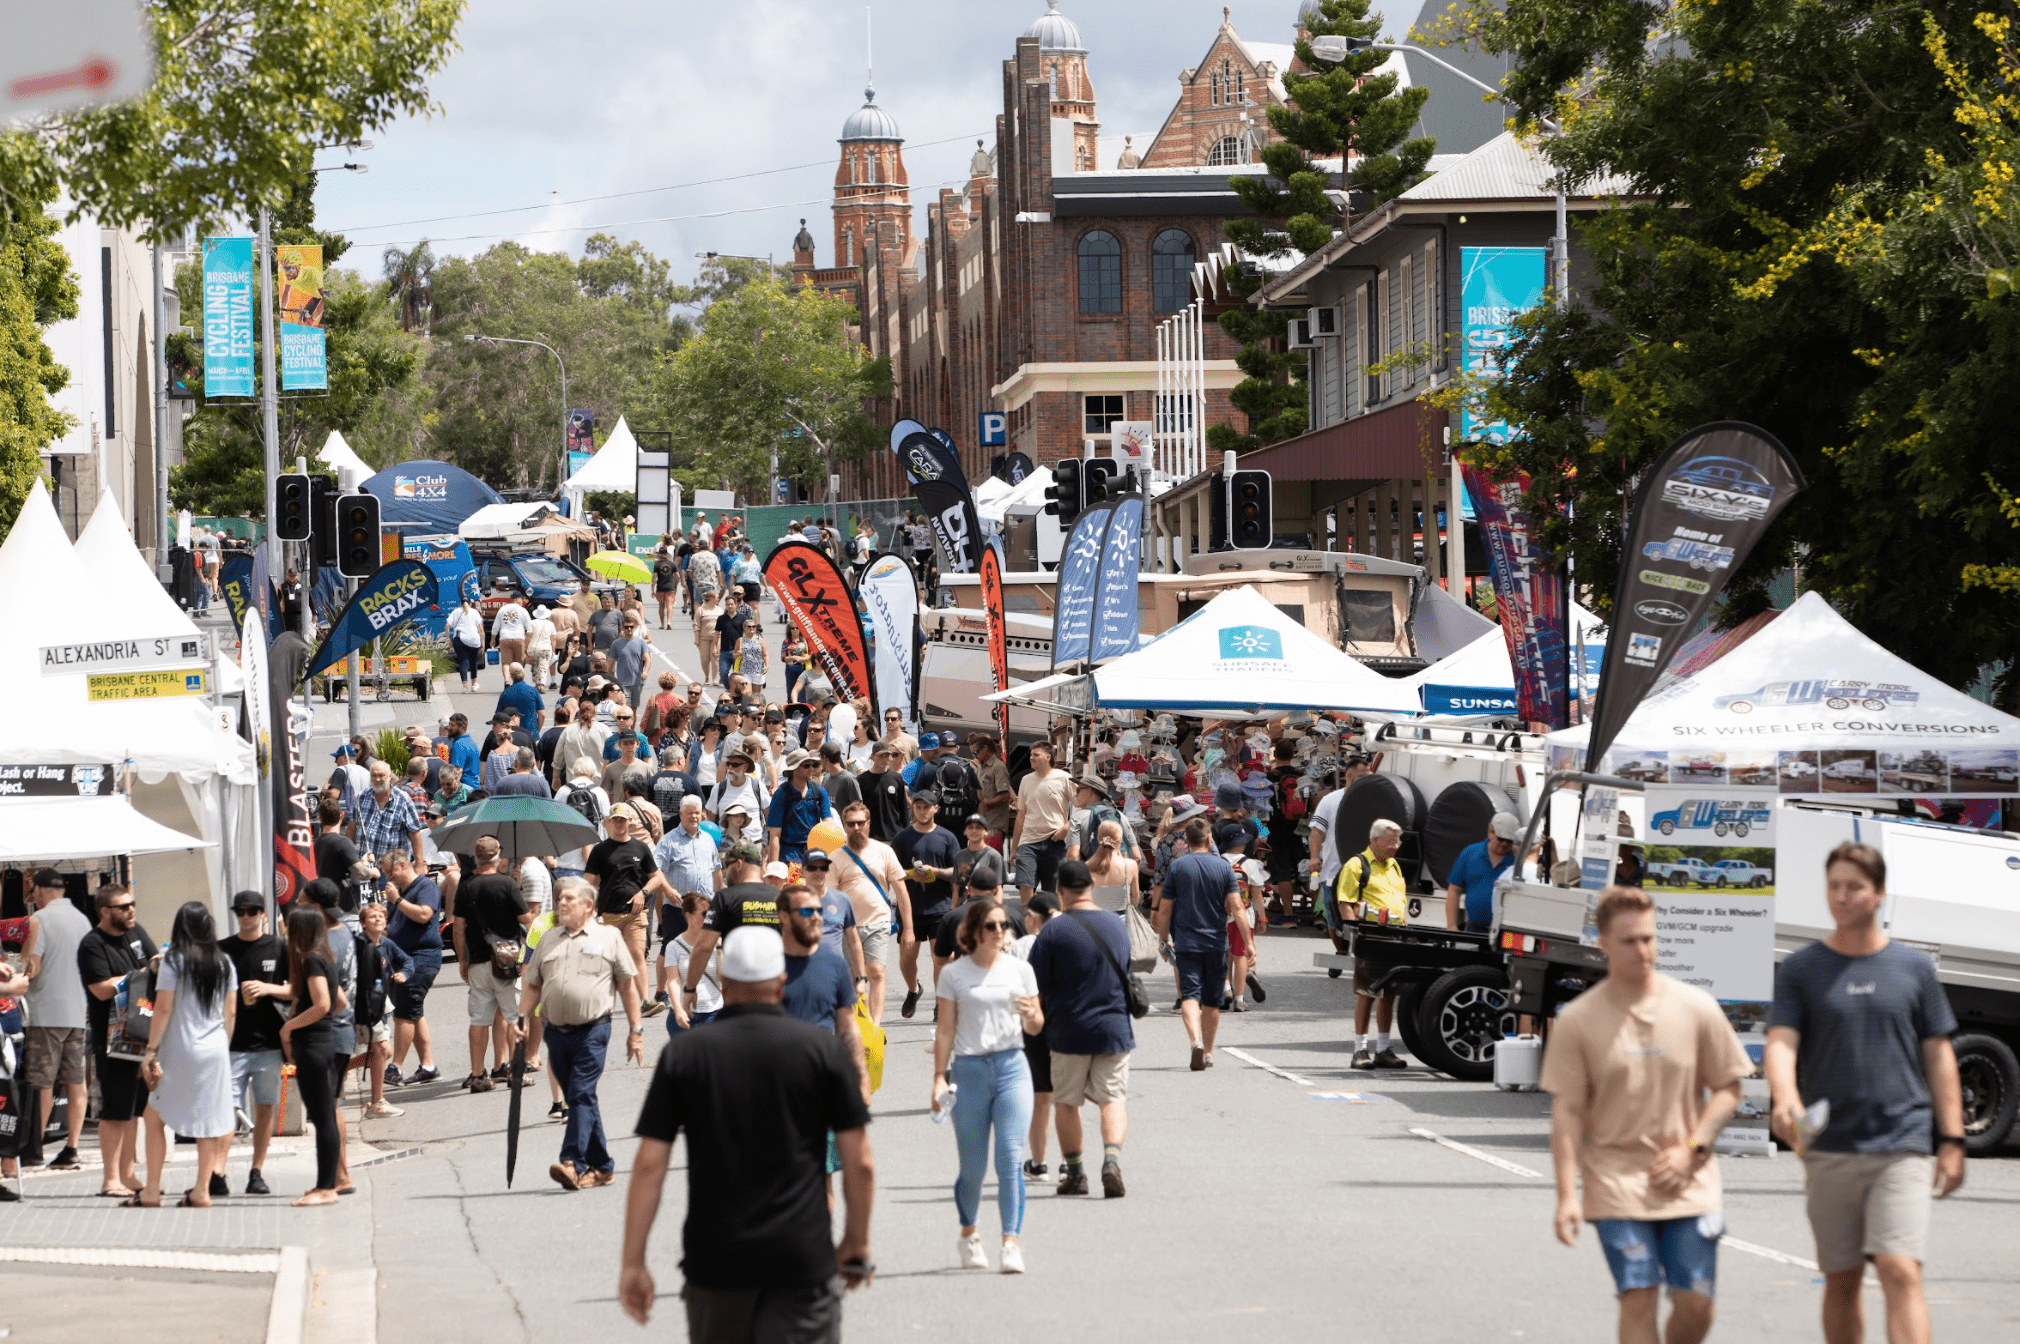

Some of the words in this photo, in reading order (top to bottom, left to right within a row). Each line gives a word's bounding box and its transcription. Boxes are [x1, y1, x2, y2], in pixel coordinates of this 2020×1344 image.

[206, 272, 249, 283] BRISBANE
[207, 285, 229, 357] CYCLING
[230, 286, 251, 357] FESTIVAL
[284, 334, 322, 344] BRISBANE
[284, 345, 323, 357] CYCLING
[285, 357, 324, 369] FESTIVAL
[984, 415, 1005, 442] P
[416, 474, 447, 485] Club
[416, 486, 447, 498] 4X4
[1673, 525, 1709, 541] Home
[1707, 533, 1724, 544] of
[428, 549, 457, 560] MORE
[358, 568, 428, 616] RACKS
[45, 641, 140, 666] ALEXANDRIA
[155, 638, 171, 656] ST
[90, 675, 136, 688] BRISBANE
[139, 672, 181, 685] CENTRAL
[1829, 679, 1872, 688] CARRY
[1876, 683, 1914, 692] MORE
[91, 688, 130, 700] TRAFFIC
[133, 686, 158, 697] AREA
[1672, 725, 1707, 736] SIX
[1715, 721, 1825, 736] WHEELER
[1832, 721, 2001, 735] CONVERSIONS
[22, 769, 36, 779] or
[36, 766, 66, 782] Hang
[1669, 906, 1705, 916] Consider
[1707, 908, 1713, 916] a
[1714, 907, 1727, 917] Six
[1728, 907, 1768, 918] Wheeler?
[1699, 924, 1734, 934] upgrade
[1673, 937, 1695, 945] more
[1655, 963, 1695, 972] Smoother
